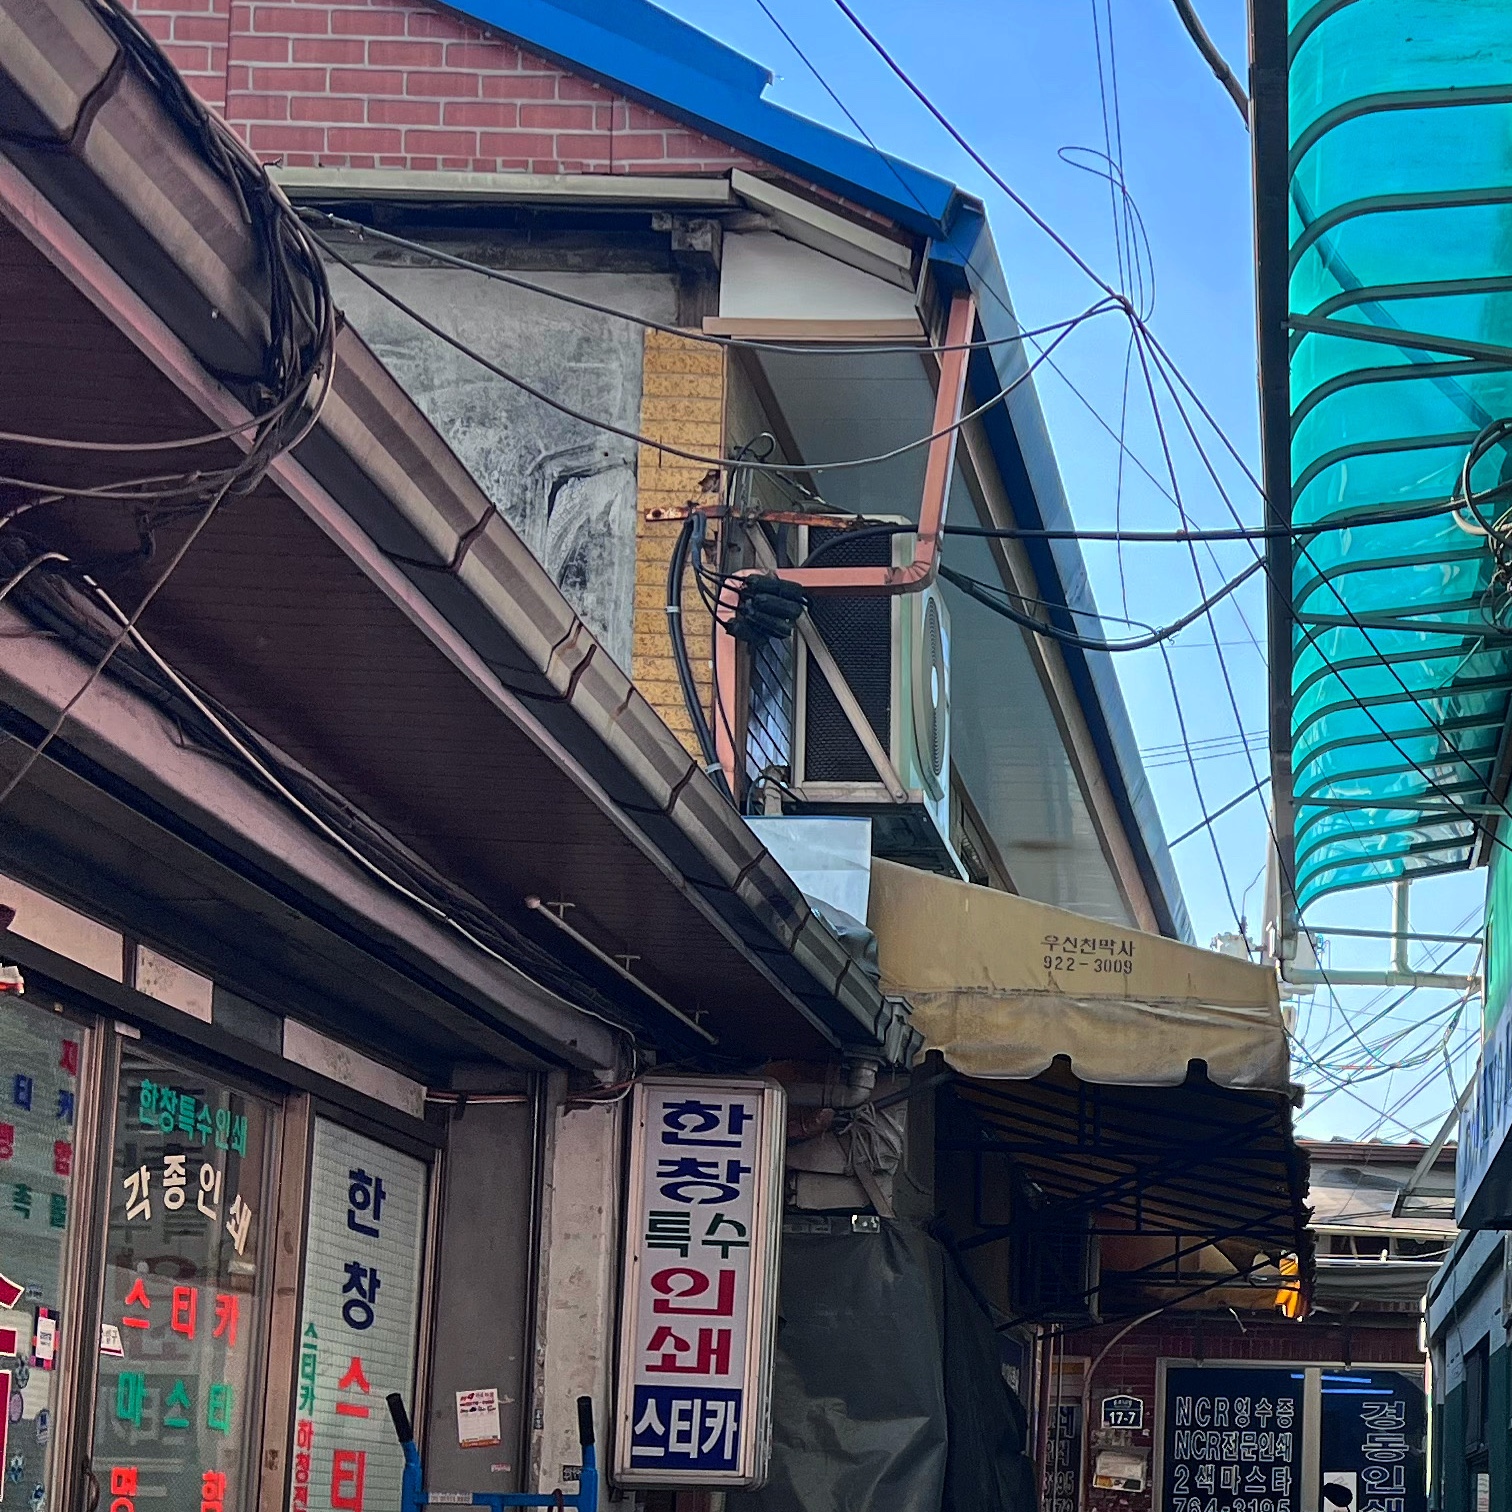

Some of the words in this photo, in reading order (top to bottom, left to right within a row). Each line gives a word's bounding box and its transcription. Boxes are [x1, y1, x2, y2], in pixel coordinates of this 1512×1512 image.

[1040, 934, 1136, 958] 우신천막사
[1042, 956, 1133, 975] 922-3009
[138, 1078, 249, 1159] 한창특수인쇄
[656, 1099, 754, 1205] 한창
[123, 1154, 252, 1257] 각종인쇄
[645, 1210, 750, 1260] 특수
[645, 1266, 736, 1376] 인쇄
[632, 1398, 738, 1461] 스티카
[1110, 1411, 1136, 1425] 17-7
